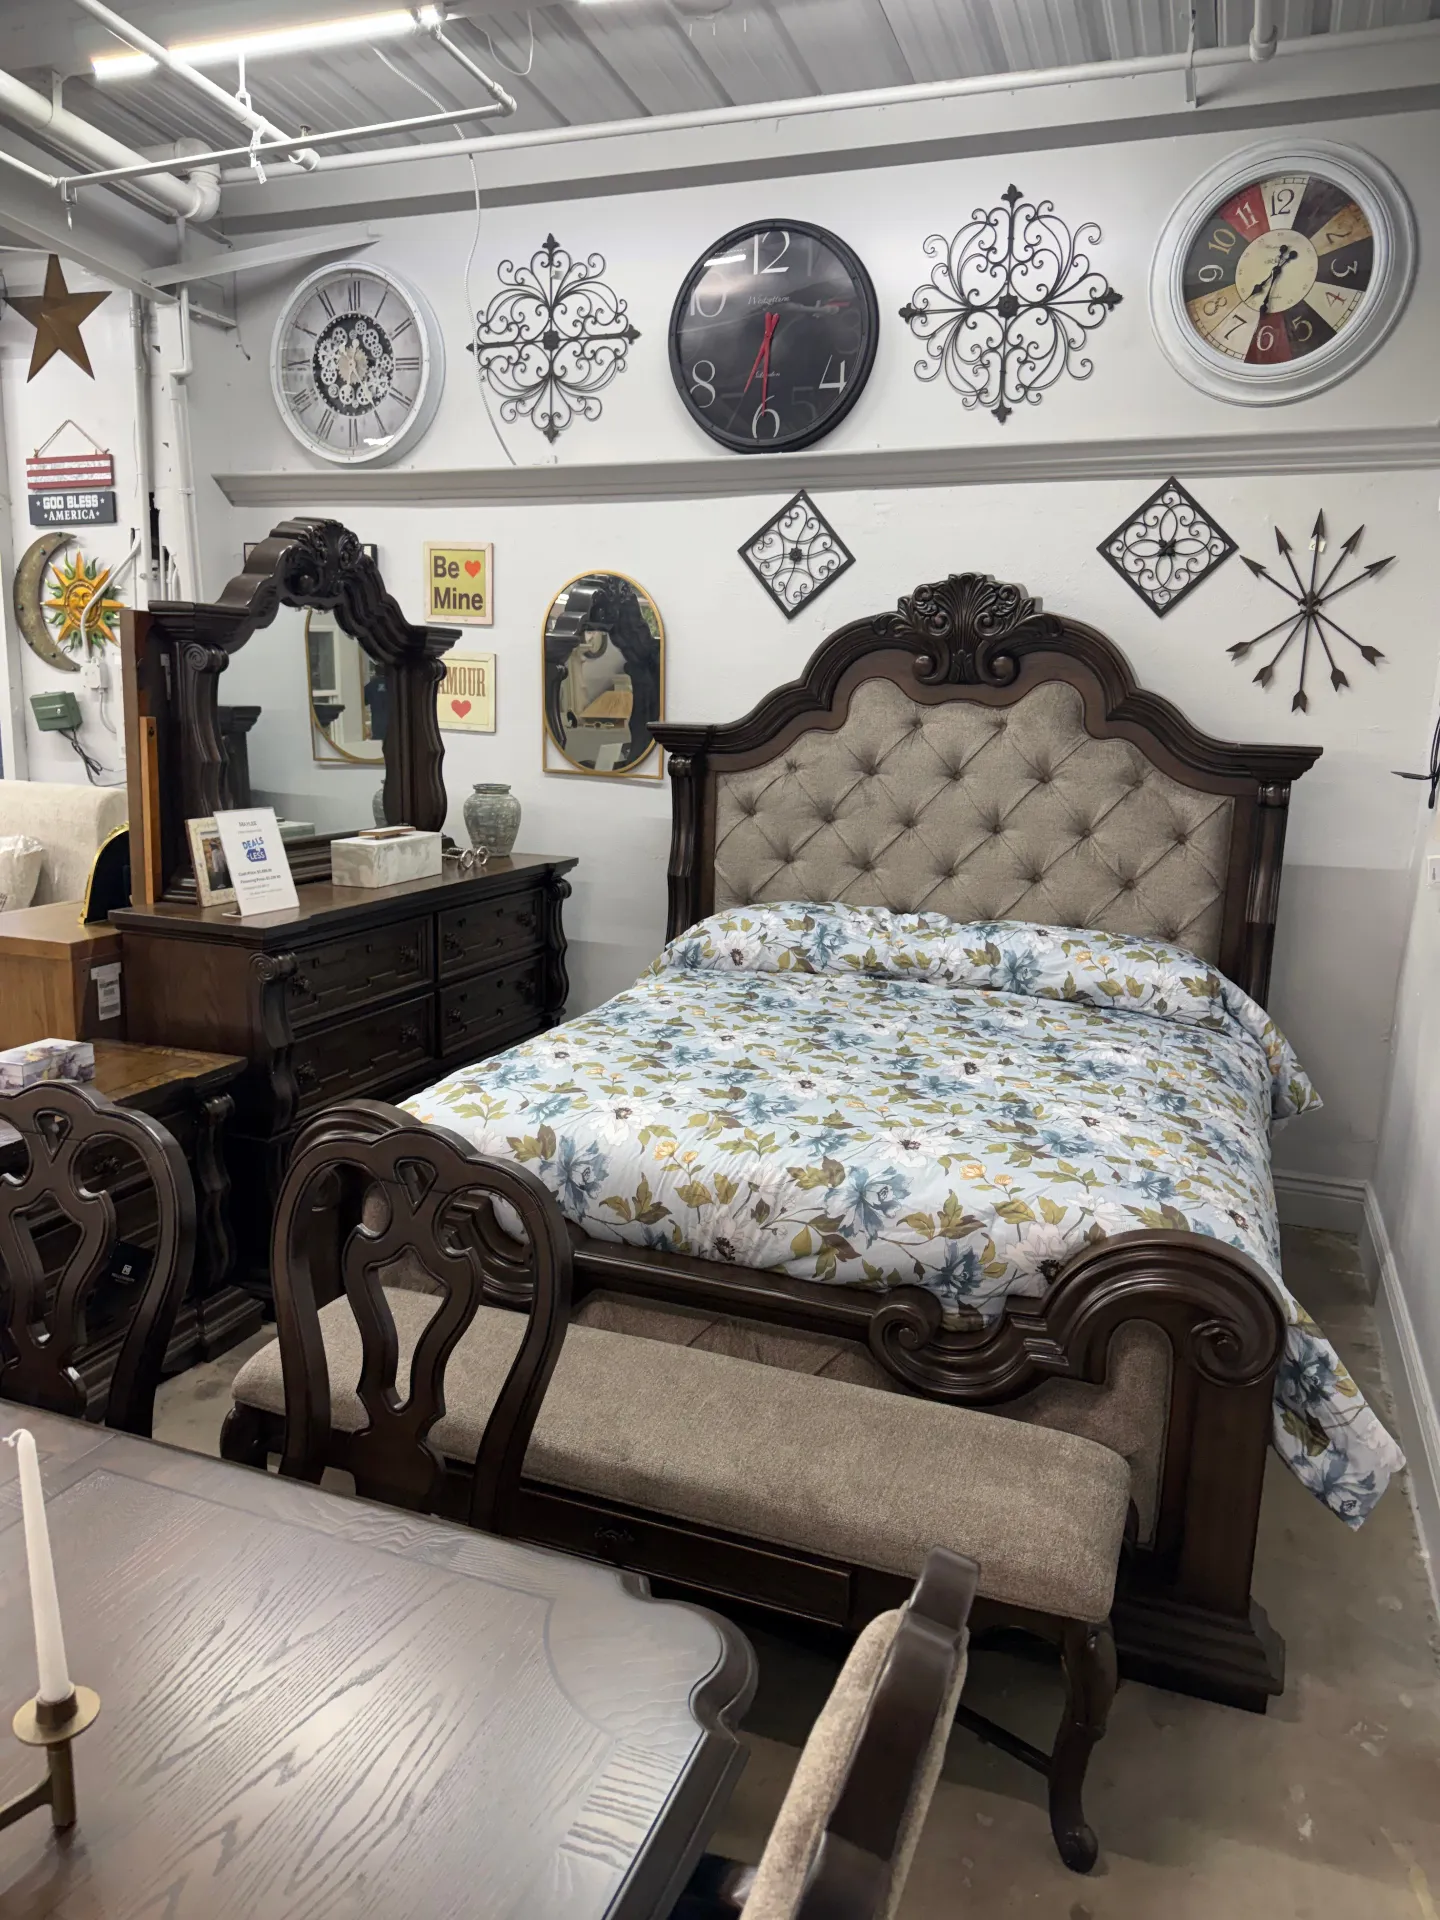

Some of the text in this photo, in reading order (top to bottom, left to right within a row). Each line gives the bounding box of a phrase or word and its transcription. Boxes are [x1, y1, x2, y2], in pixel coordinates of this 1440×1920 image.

[1235, 201, 1259, 229] 11
[1270, 189, 1295, 217] 12
[1208, 228, 1236, 254] 10
[1326, 221, 1352, 244] 2
[752, 230, 790, 276] 12
[1198, 264, 1224, 283] 9
[1331, 258, 1358, 278] 3
[690, 271, 727, 318] 10
[1203, 296, 1227, 317] 8
[1325, 291, 1348, 308] 4
[1224, 314, 1248, 340] 7
[1256, 325, 1275, 351] 6
[1292, 316, 1313, 342] 5
[689, 359, 716, 408] 8
[818, 354, 848, 394] 4
[751, 394, 781, 439] 6
[43, 494, 98, 509] GOD BLESS
[49, 509, 95, 521] AMERICA
[433, 555, 460, 579] Be
[433, 586, 484, 611] Mine
[242, 836, 264, 850] DEALS
[249, 850, 265, 860] LESS
